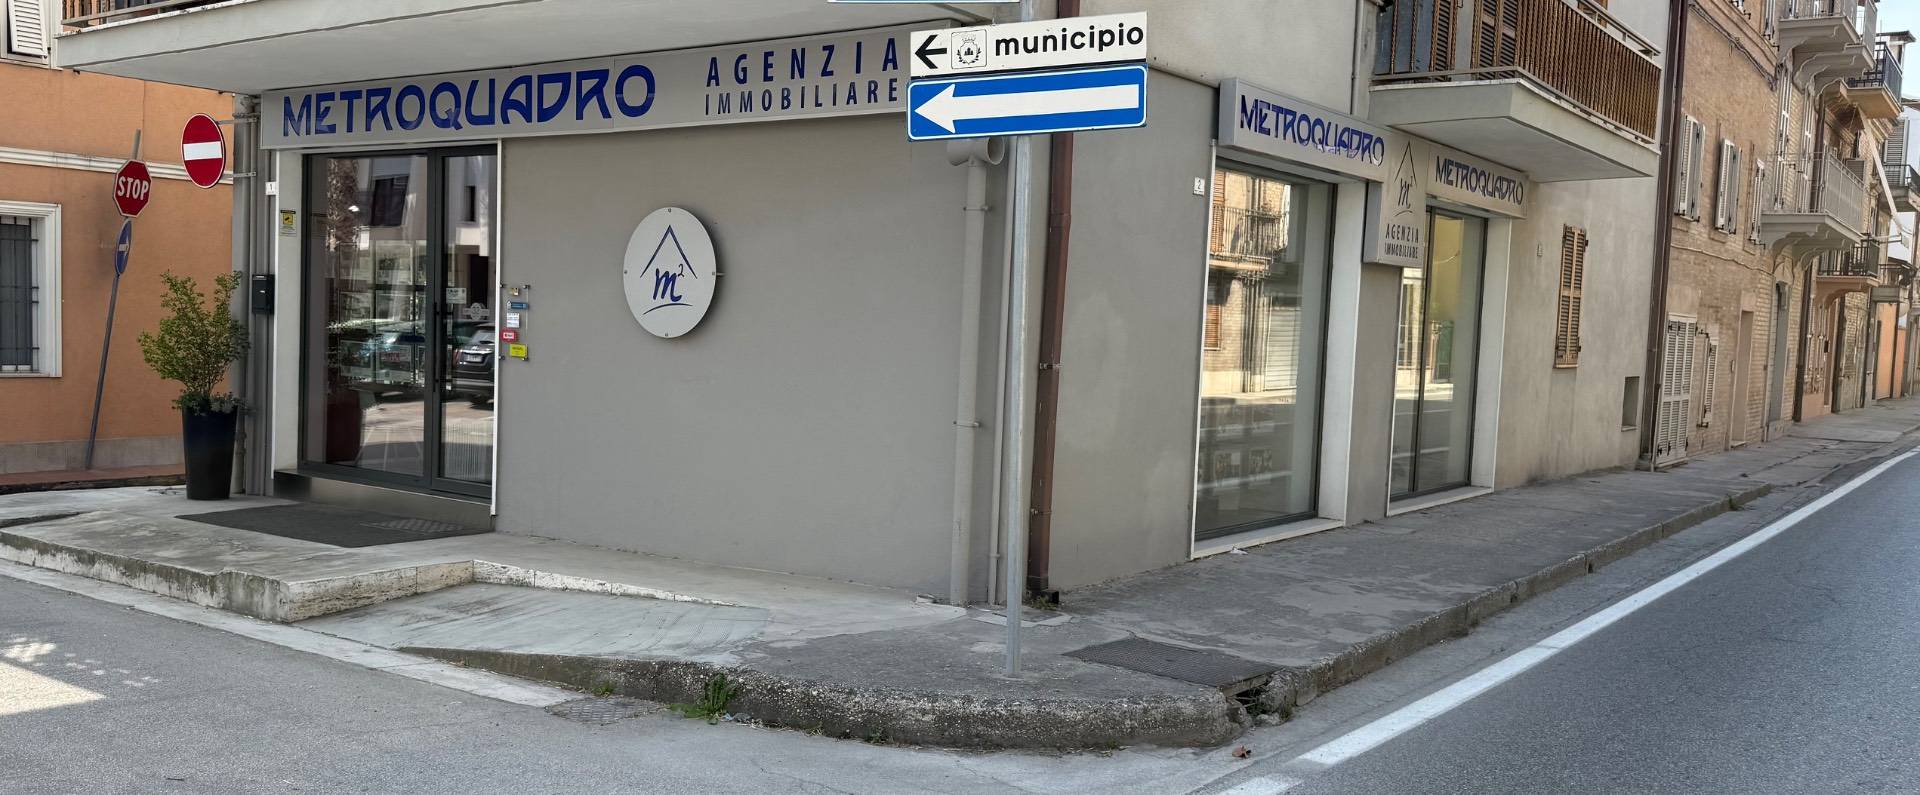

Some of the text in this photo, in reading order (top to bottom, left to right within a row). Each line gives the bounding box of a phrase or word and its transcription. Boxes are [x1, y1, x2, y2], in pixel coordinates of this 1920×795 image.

[995, 22, 1144, 57] municipio
[706, 38, 899, 87] AGENZIA
[283, 64, 656, 137] METROQUADRO
[705, 78, 898, 116] IMMOBILIARE
[1240, 95, 1385, 167] METROQUADRO
[117, 175, 149, 201] STOP
[1435, 155, 1524, 206] METROQUADRO
[1384, 243, 1419, 259] IMMOBILIARE
[1385, 223, 1419, 244] AGENZIA
